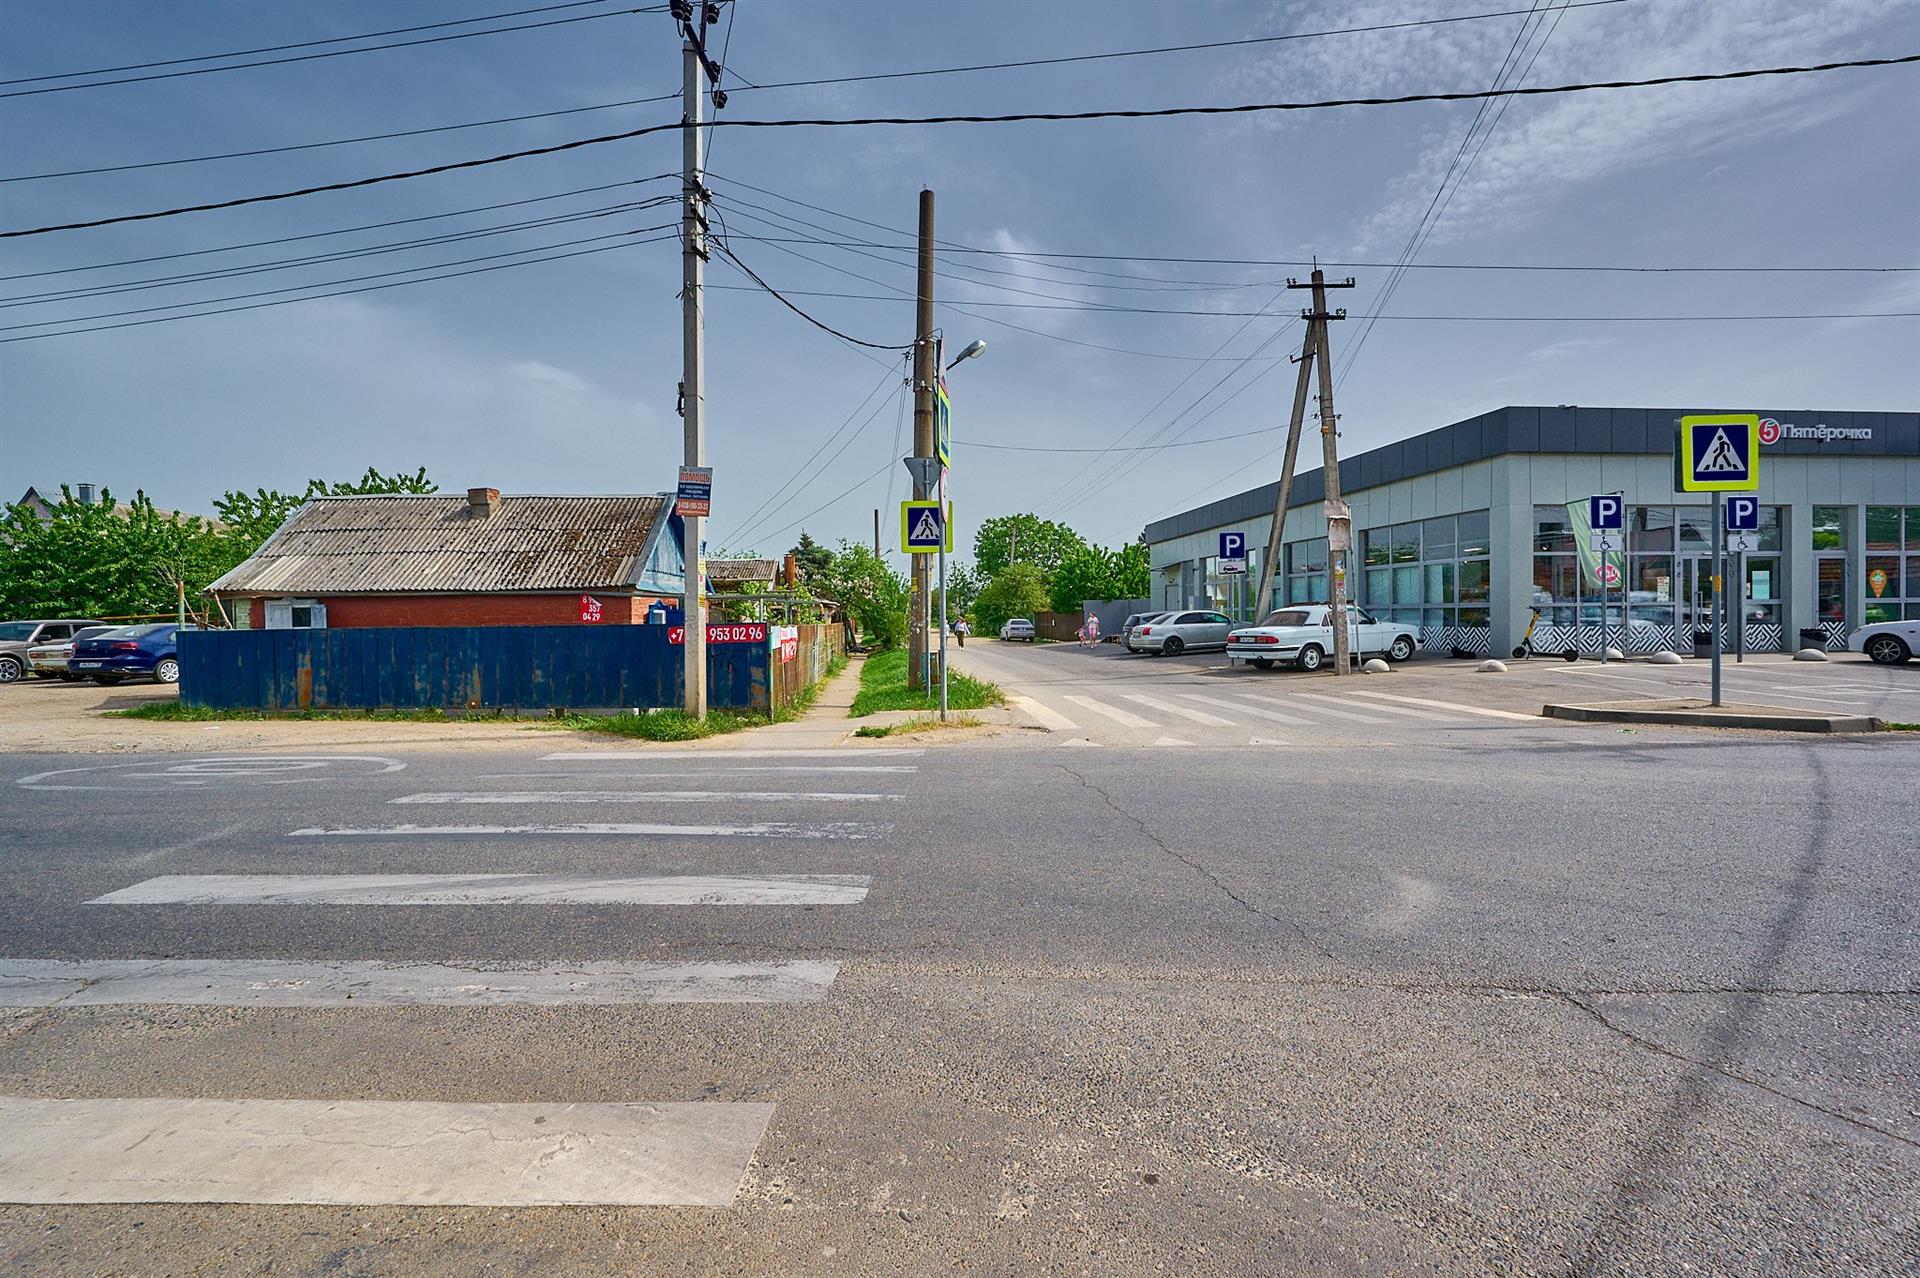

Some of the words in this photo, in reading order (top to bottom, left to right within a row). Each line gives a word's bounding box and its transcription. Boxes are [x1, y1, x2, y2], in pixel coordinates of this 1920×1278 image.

[1781, 424, 1872, 442] Пятёрочка
[1599, 499, 1617, 526] P
[1735, 500, 1753, 526] P
[1226, 535, 1241, 556] P
[671, 628, 684, 642] +7
[709, 627, 730, 641] 953
[732, 626, 747, 640] 02
[748, 626, 763, 640] 96
